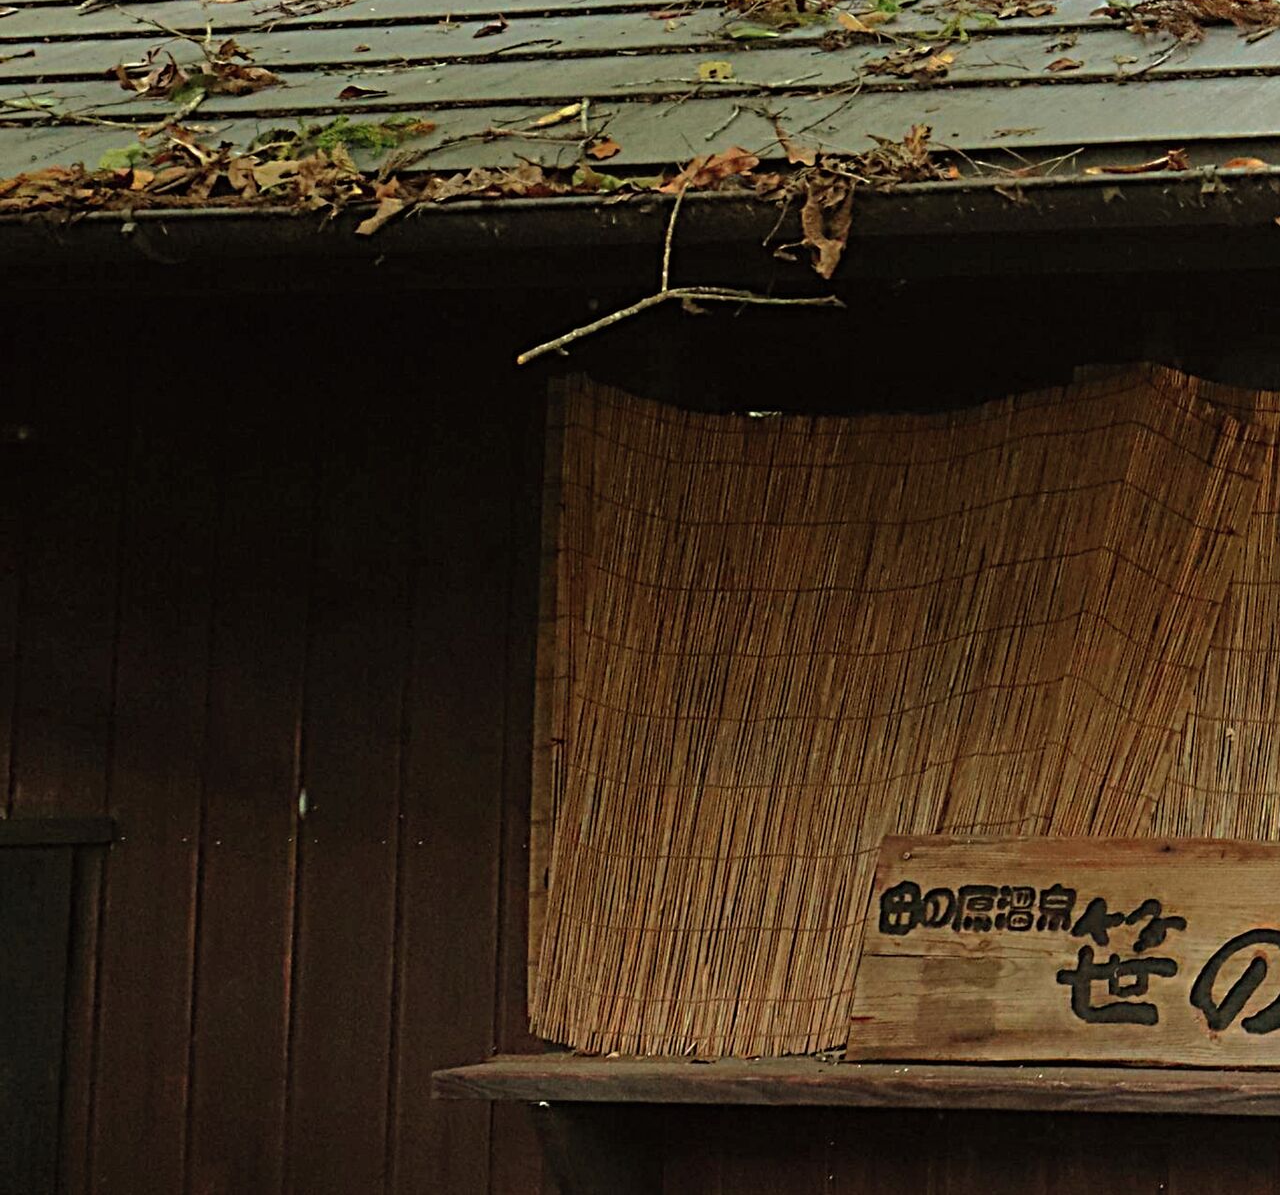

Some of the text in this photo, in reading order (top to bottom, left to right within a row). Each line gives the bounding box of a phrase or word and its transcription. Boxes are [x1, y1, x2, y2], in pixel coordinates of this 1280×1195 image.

[879, 880, 1078, 935] 田の原温泉
